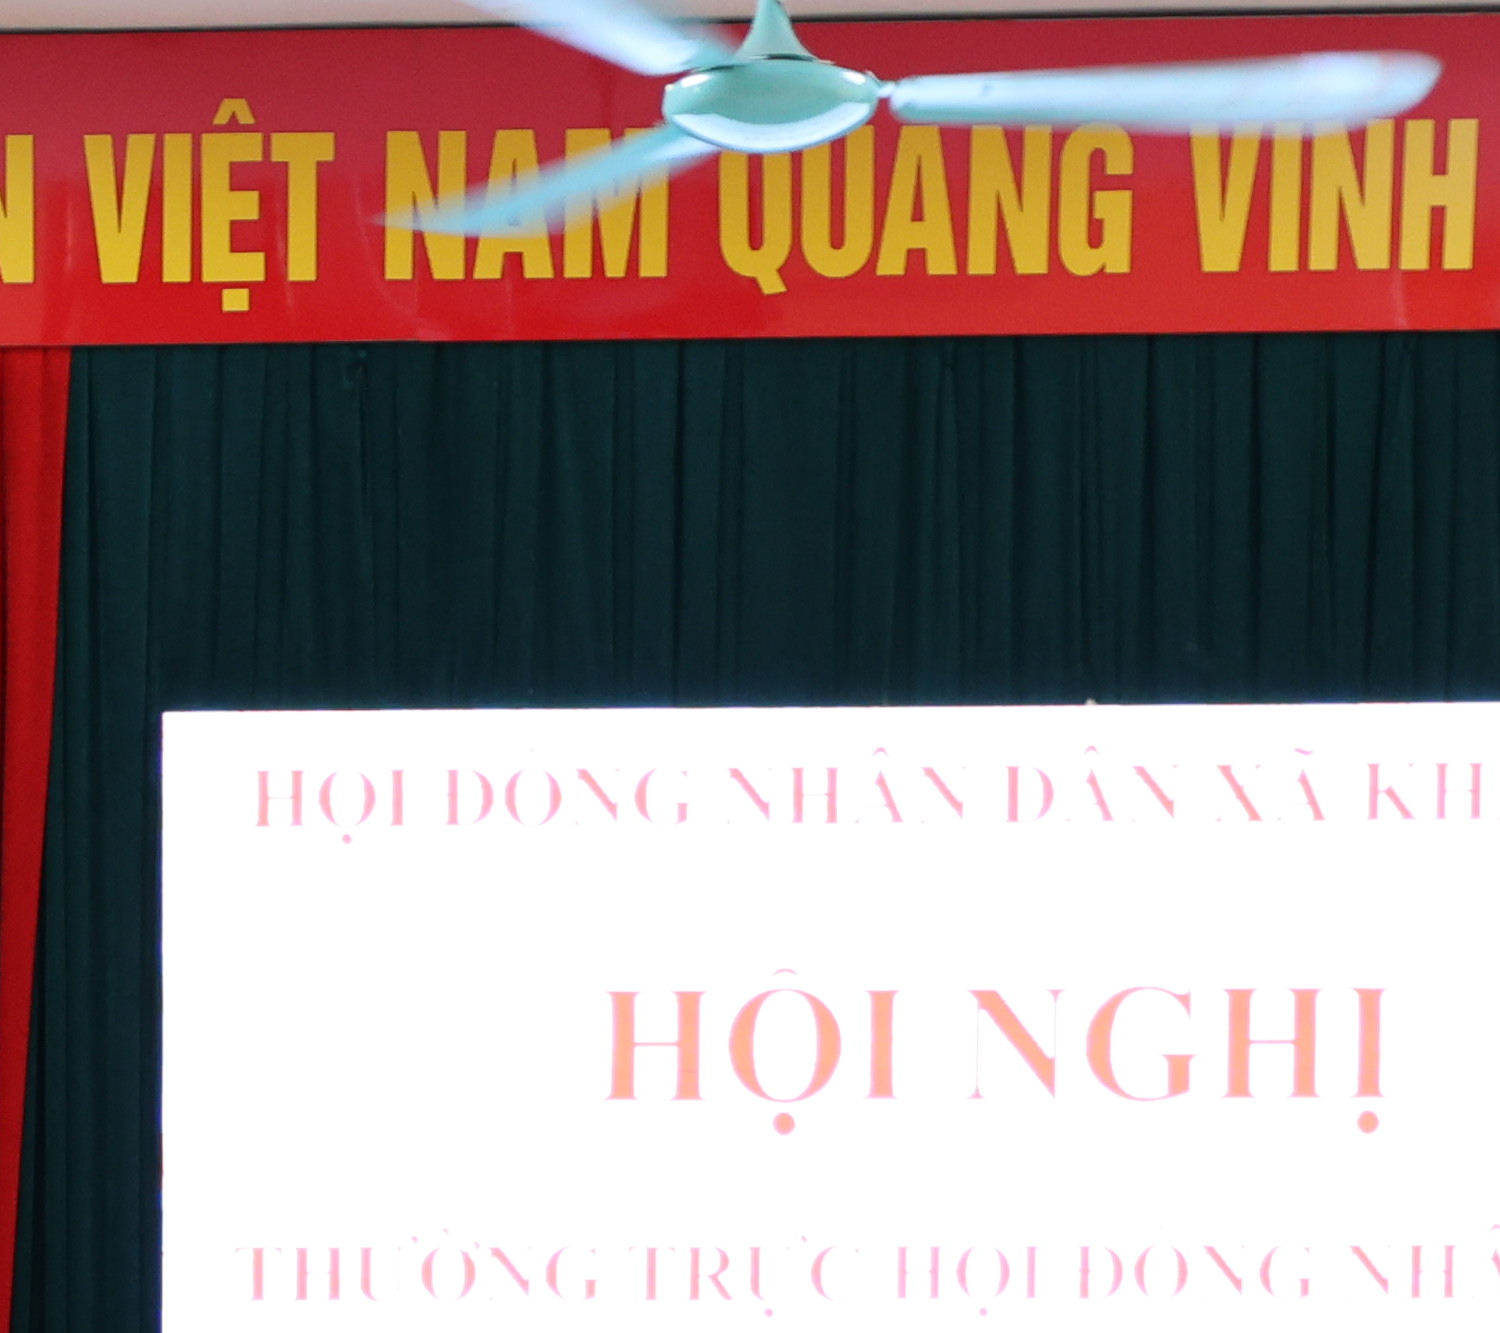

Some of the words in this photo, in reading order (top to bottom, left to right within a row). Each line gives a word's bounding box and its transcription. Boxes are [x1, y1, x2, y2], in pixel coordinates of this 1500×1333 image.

[84, 98, 335, 312] VIỆT
[384, 128, 669, 280] NAM
[718, 120, 1134, 295] QUANG
[1215, 746, 1328, 823] XÃ
[603, 967, 901, 1137] HỘI
[965, 984, 1388, 1136] NGHỊ
